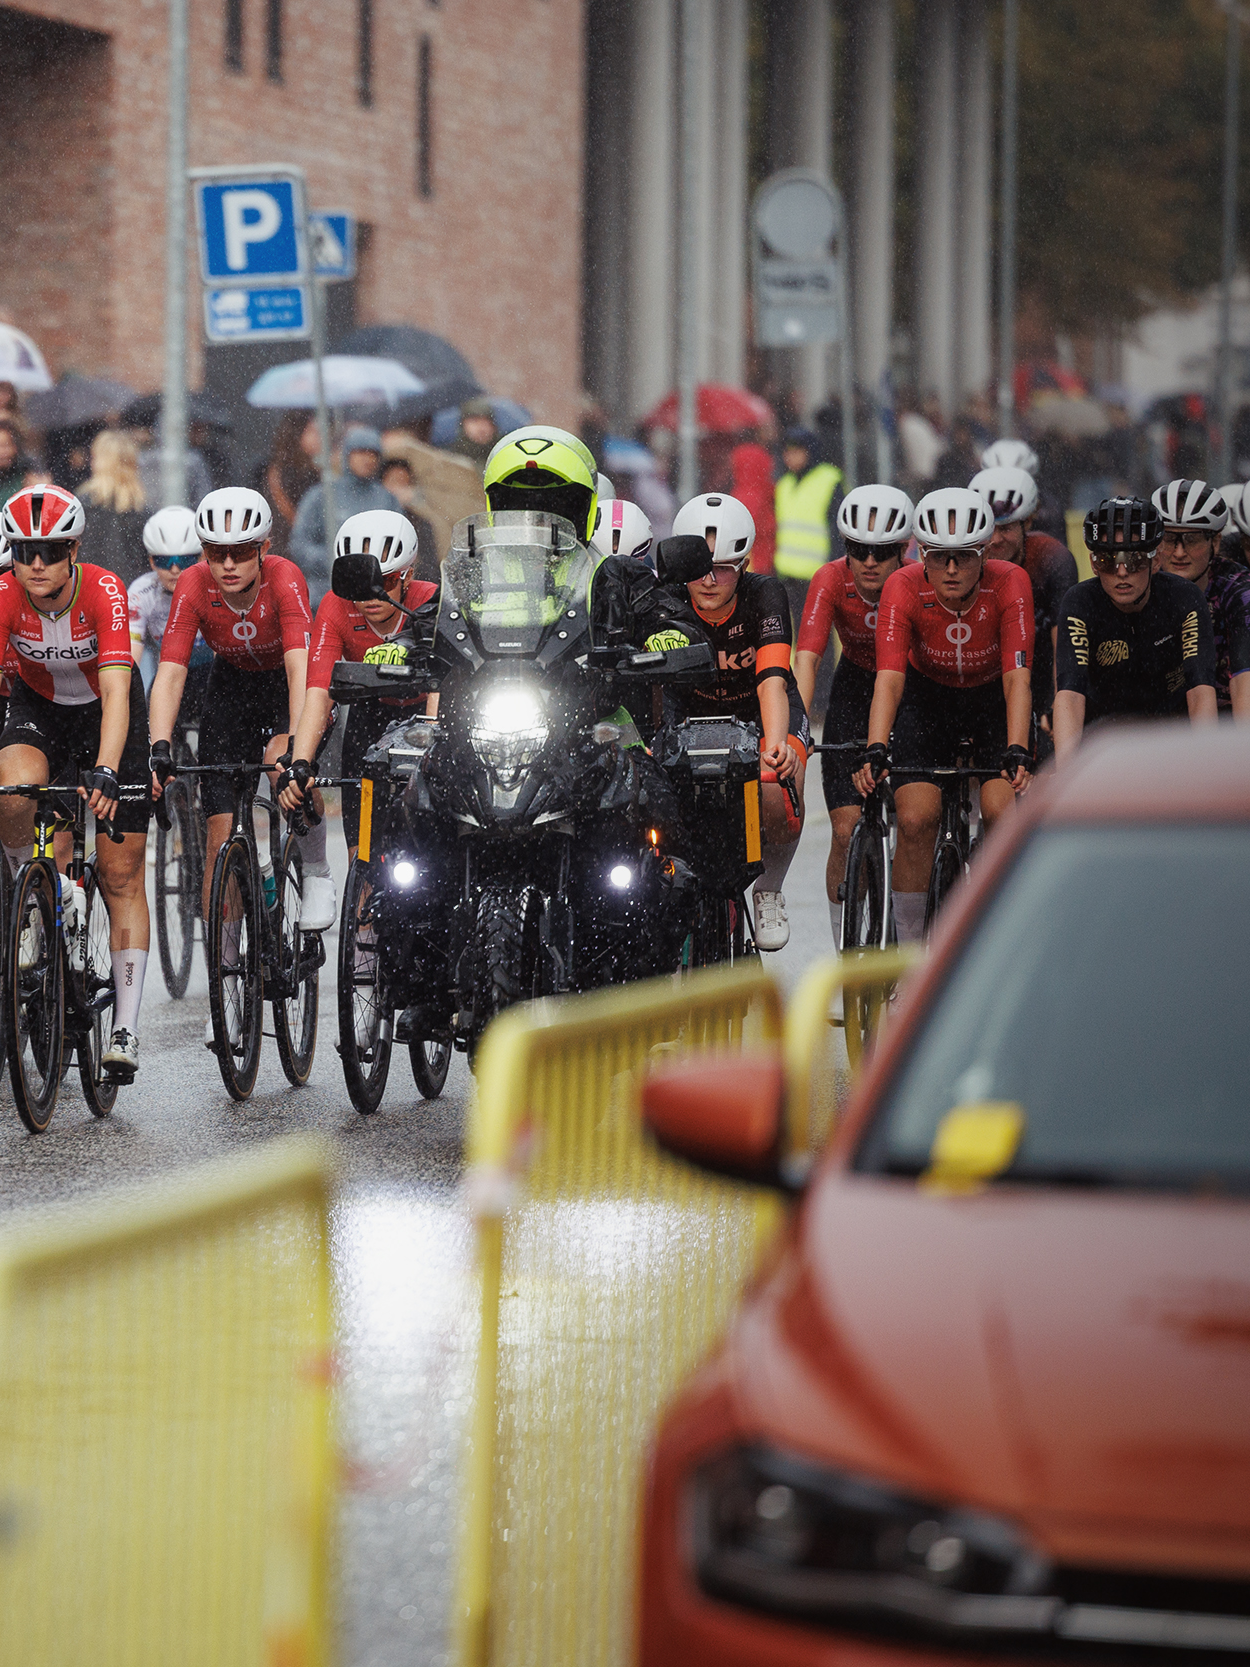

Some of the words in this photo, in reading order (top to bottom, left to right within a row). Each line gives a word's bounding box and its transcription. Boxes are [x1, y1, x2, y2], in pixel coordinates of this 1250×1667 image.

[221, 188, 282, 271] P
[98, 574, 126, 631] Cofidis
[20, 630, 41, 640] uvex
[1181, 610, 1199, 660] RACING
[17, 641, 93, 660] Cofidis
[920, 640, 999, 660] Sparekassen
[1098, 640, 1128, 651] PASTA
